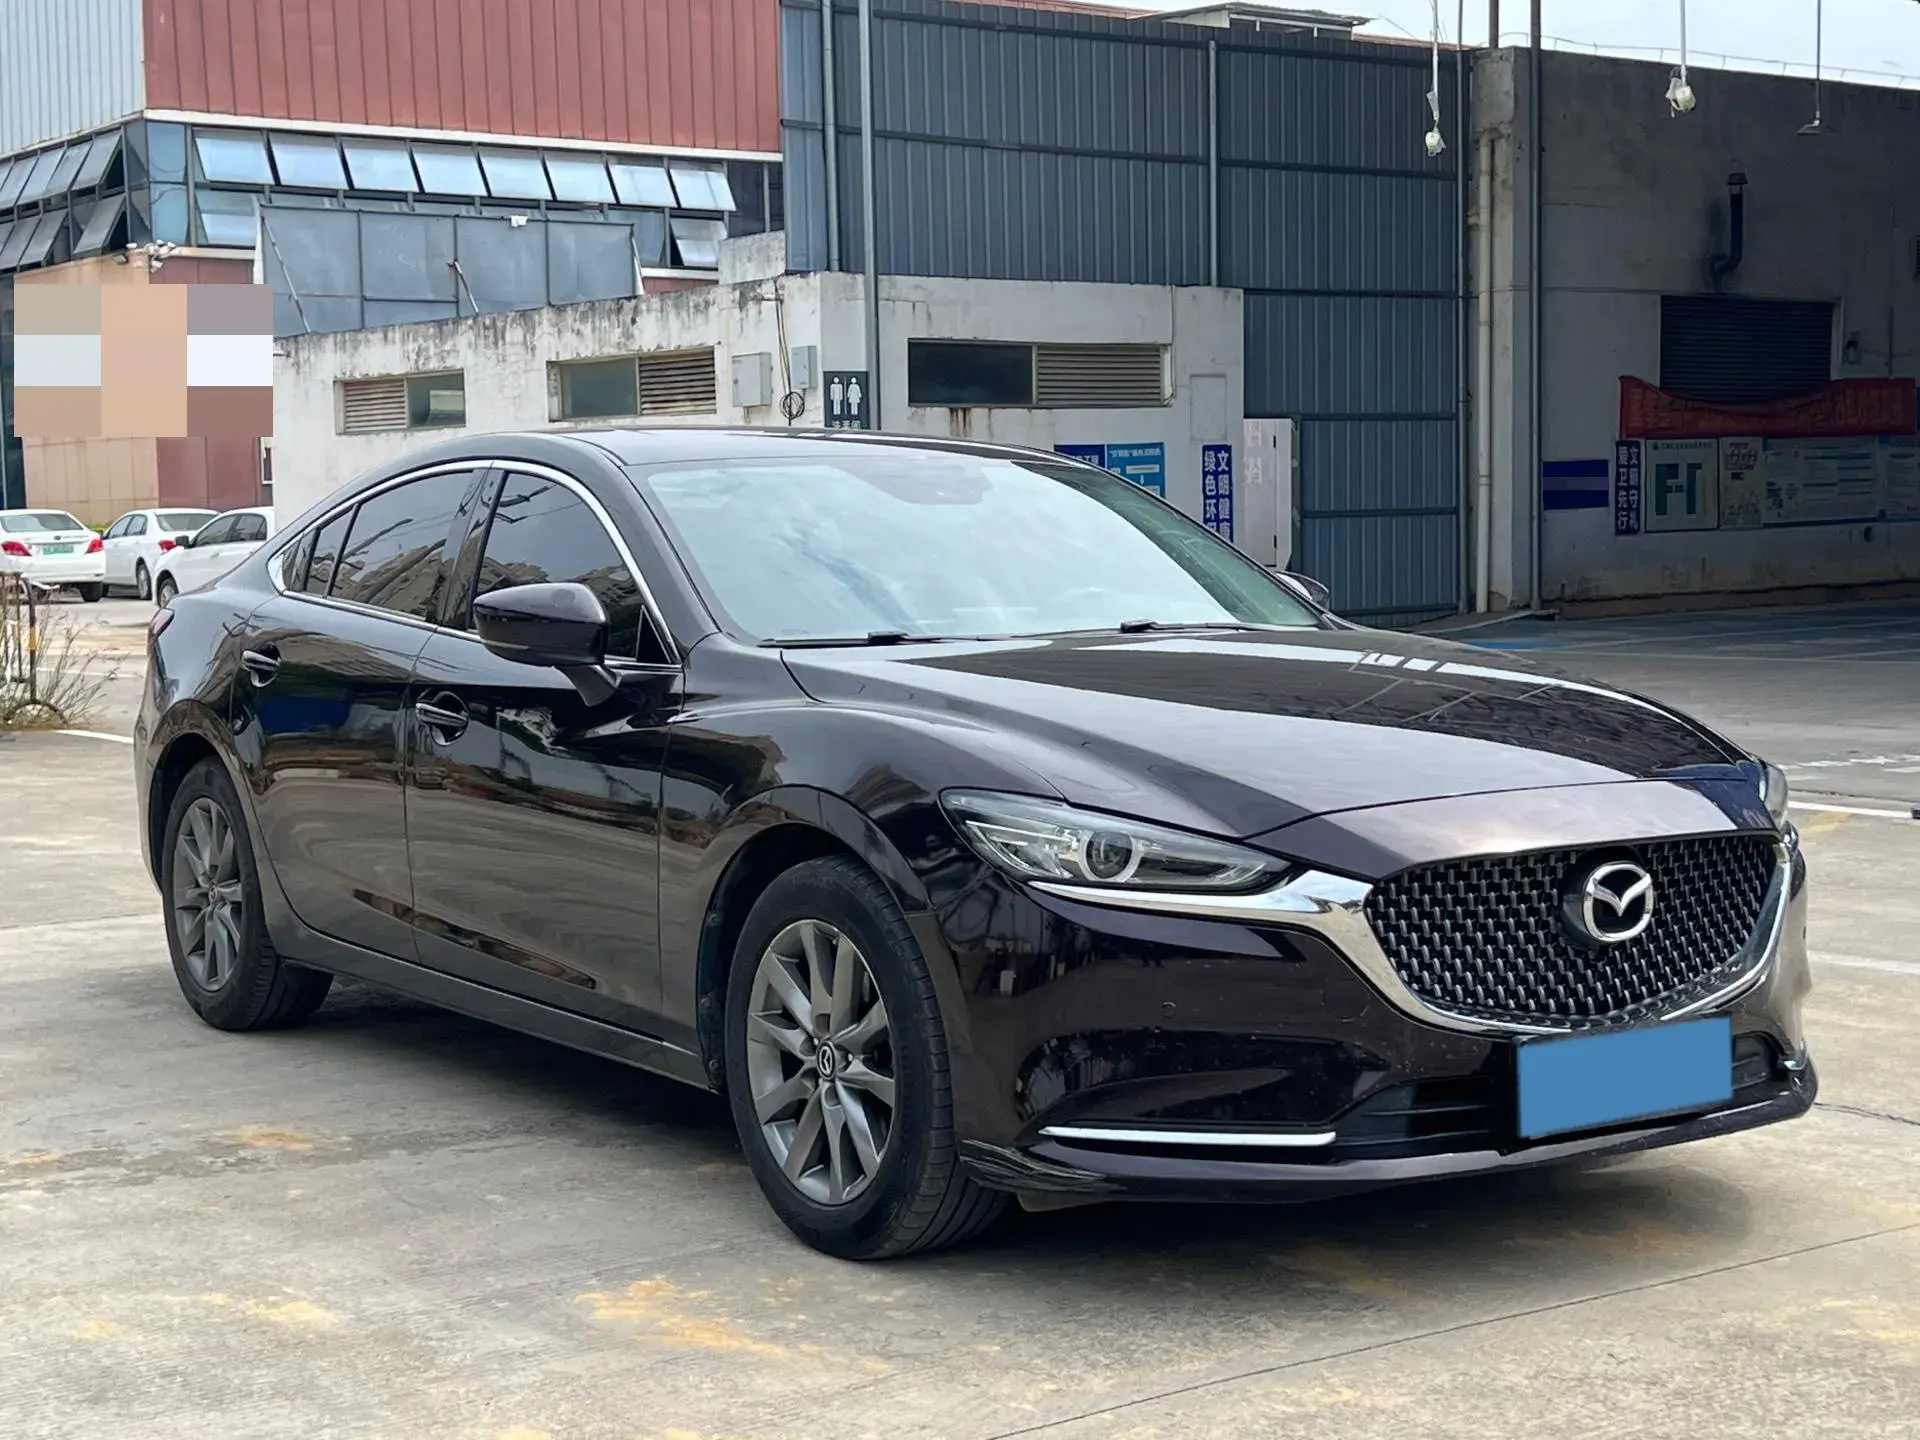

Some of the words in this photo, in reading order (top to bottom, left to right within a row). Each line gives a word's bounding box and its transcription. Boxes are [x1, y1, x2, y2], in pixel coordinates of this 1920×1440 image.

[1217, 450, 1231, 541] 文明健康
[1617, 445, 1629, 531] 爱卫先行
[1629, 446, 1639, 531] 文明守礼
